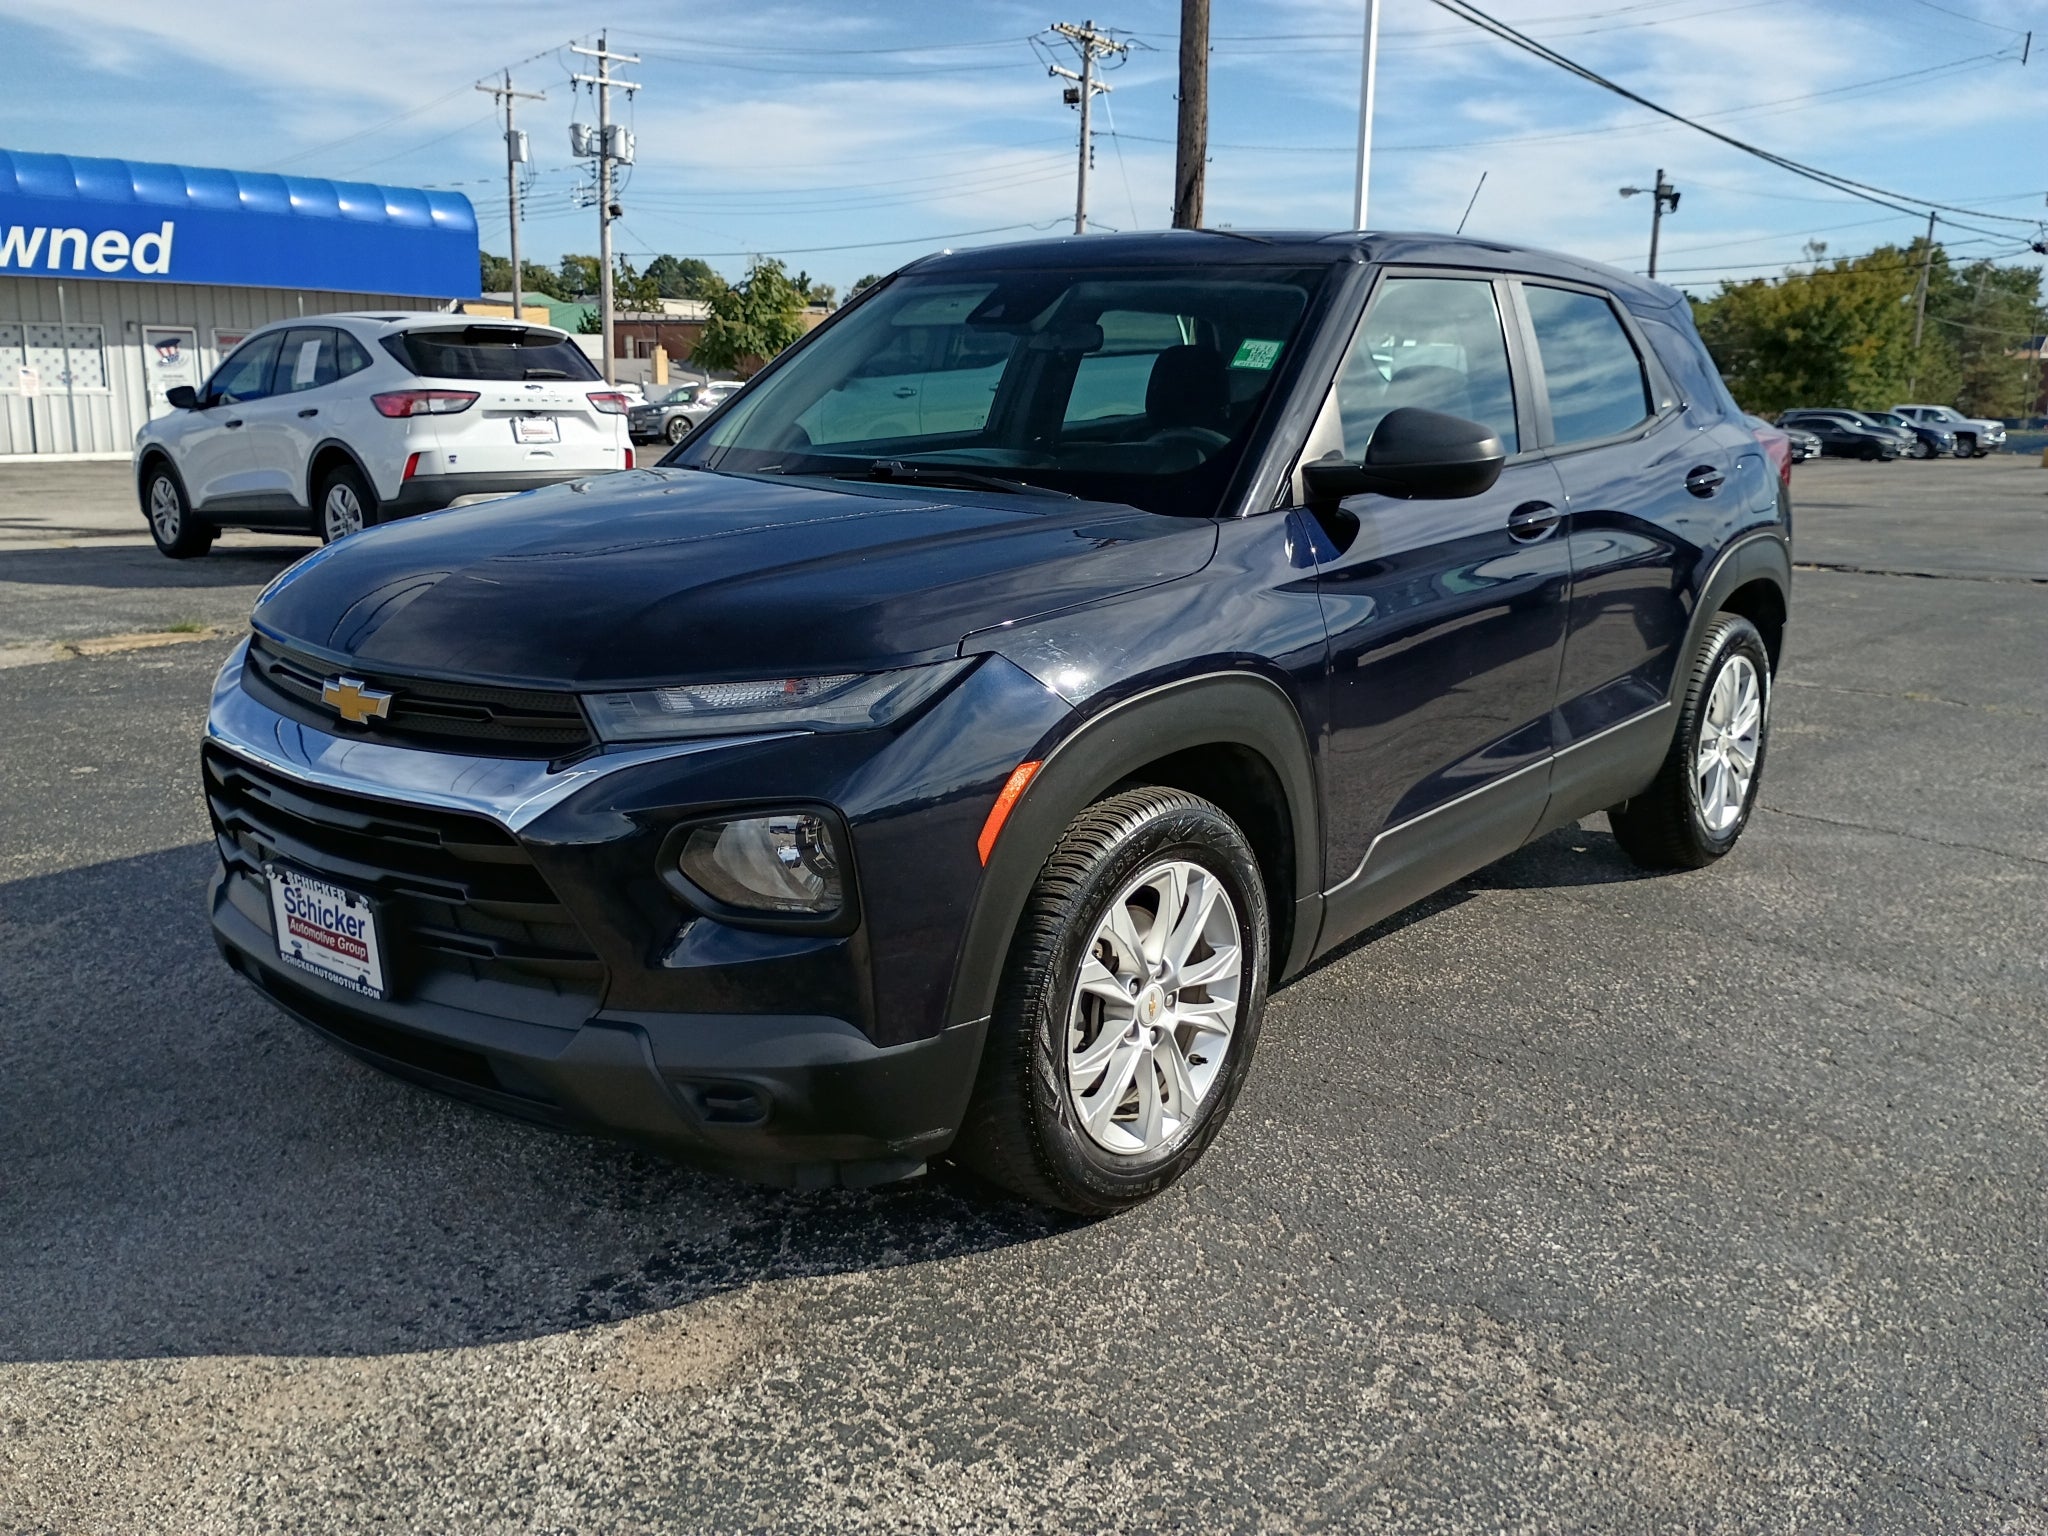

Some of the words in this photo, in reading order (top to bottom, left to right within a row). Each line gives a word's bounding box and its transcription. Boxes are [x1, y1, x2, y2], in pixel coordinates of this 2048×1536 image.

[285, 870, 346, 902] SCHICKER
[284, 886, 366, 940] Schicker
[289, 918, 336, 947] Automotive
[337, 935, 367, 959] Group
[281, 952, 381, 1000] SCHICKERAUTOMOTIVE.COM
